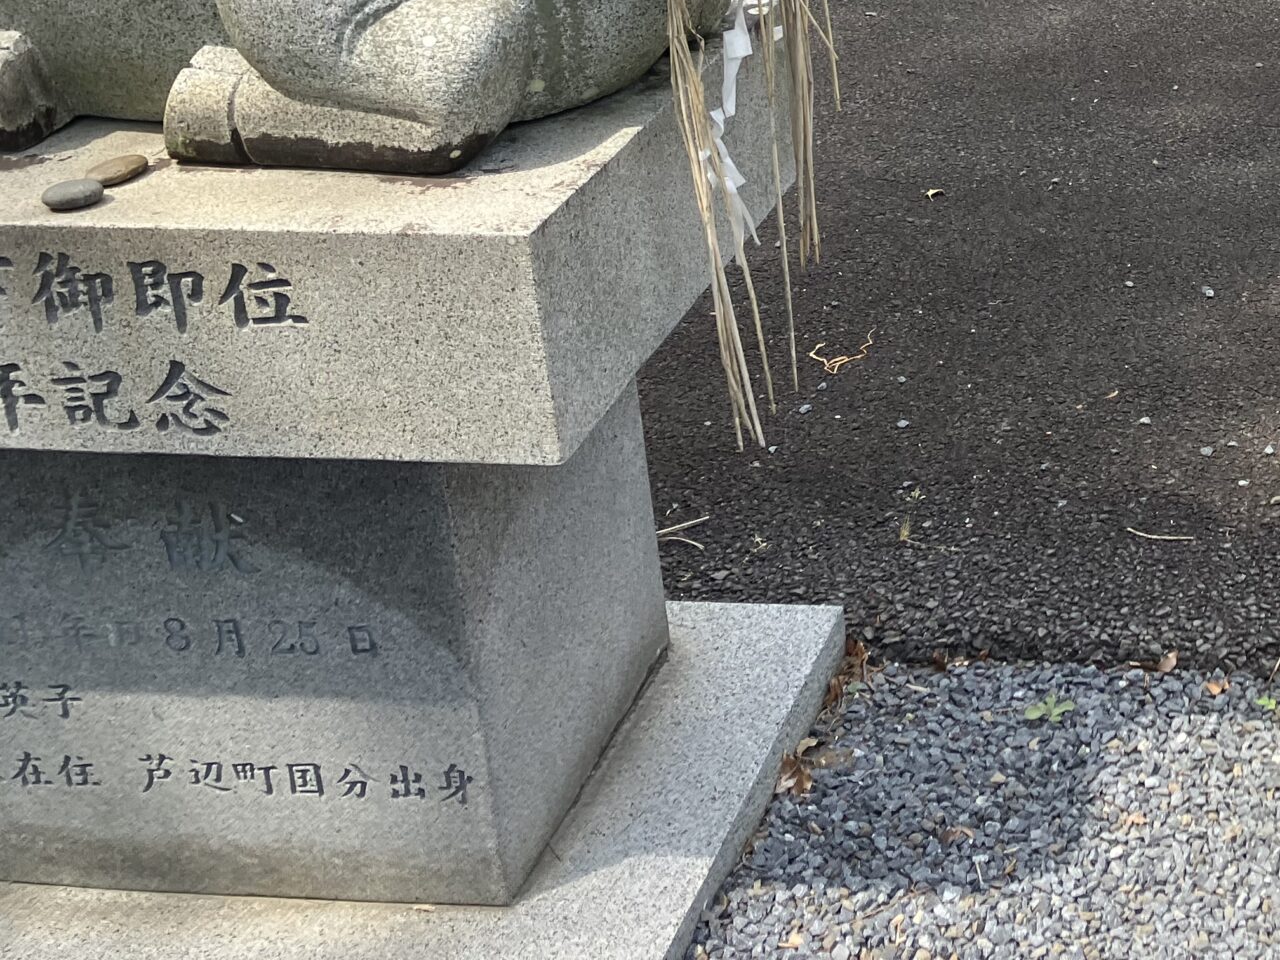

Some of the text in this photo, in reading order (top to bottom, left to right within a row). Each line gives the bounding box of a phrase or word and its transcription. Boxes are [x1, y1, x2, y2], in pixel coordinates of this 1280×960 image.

[0, 251, 309, 335] 御即位
[138, 753, 476, 805] 芦辺町国分出身
